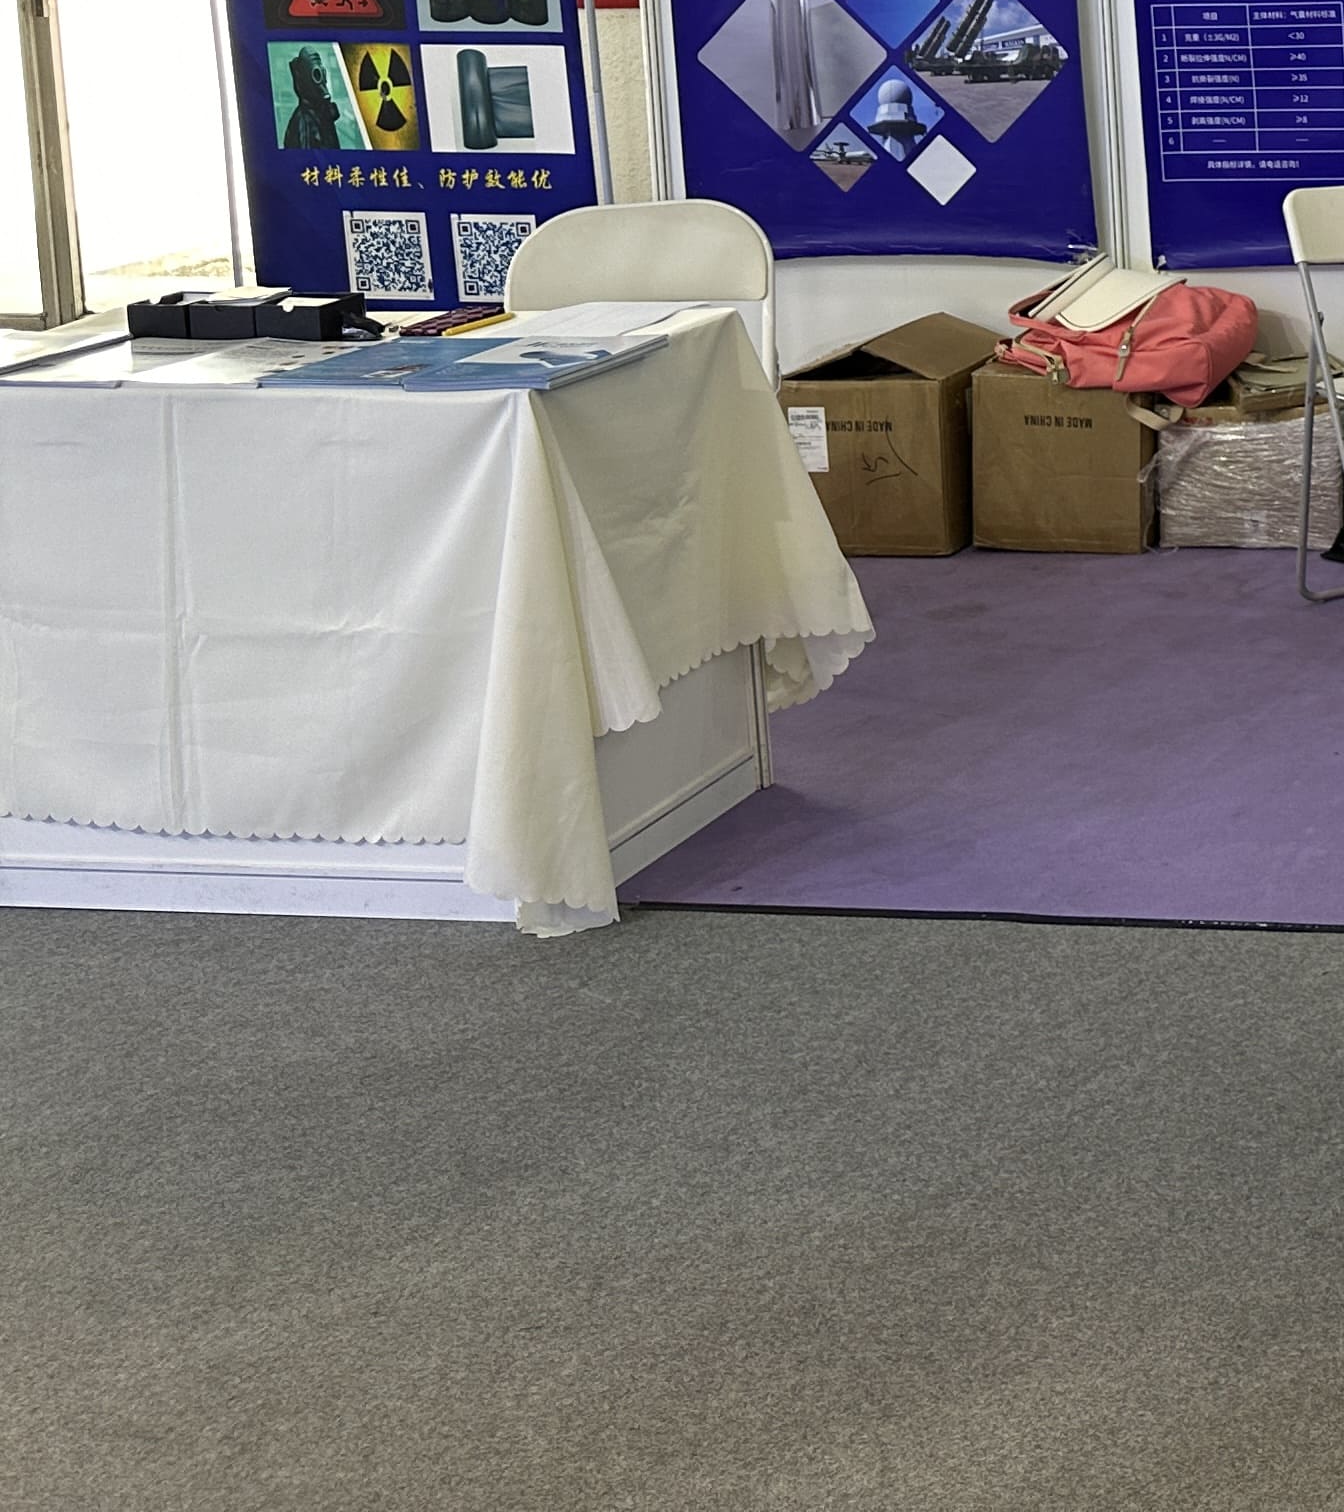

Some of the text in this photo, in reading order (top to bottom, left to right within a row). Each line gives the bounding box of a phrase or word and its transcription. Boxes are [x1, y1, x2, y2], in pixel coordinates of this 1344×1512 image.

[854, 421, 865, 432] IN
[868, 421, 892, 432] MADE
[1024, 415, 1092, 428] MADE IN CHINA
